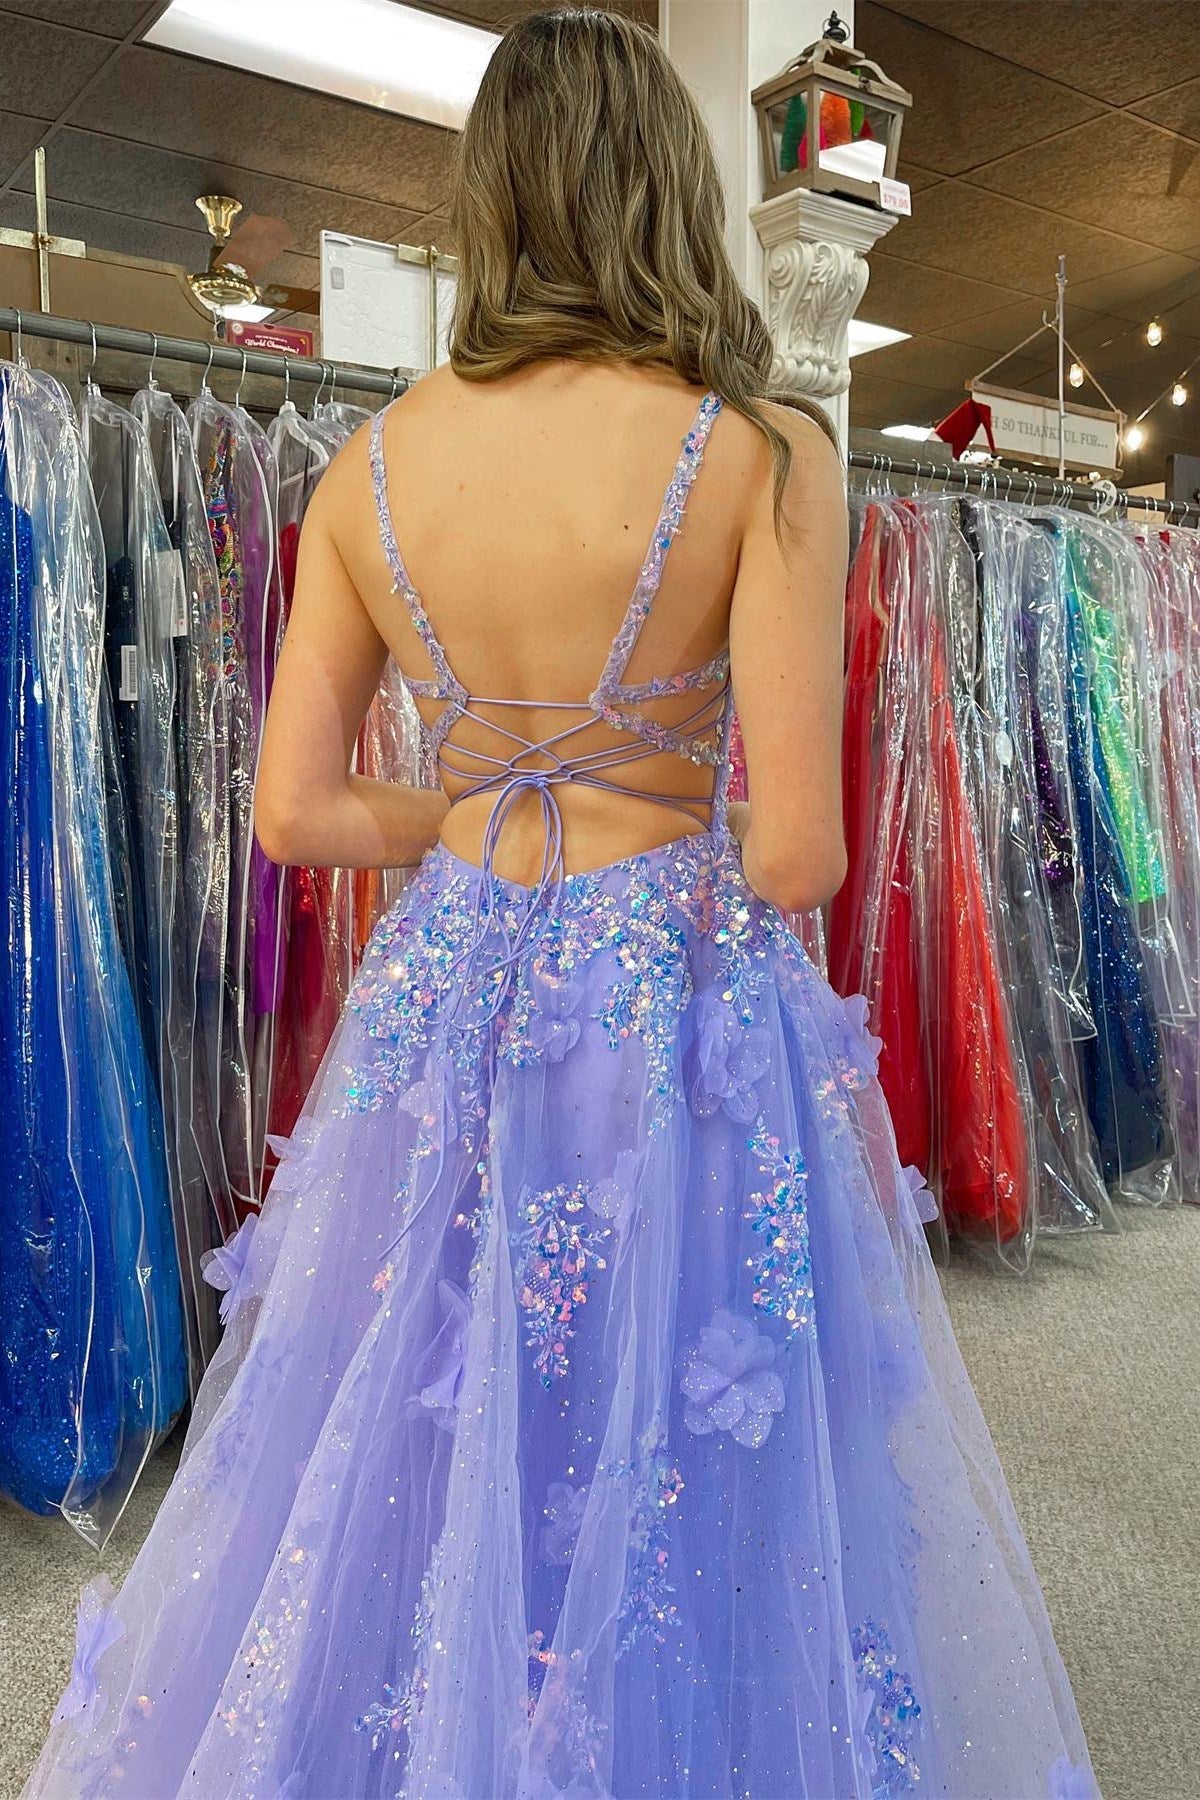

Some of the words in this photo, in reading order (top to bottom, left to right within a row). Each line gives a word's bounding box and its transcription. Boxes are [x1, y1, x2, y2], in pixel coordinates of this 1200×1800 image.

[244, 338, 266, 347] World
[1001, 418, 1015, 432] SO
[1017, 421, 1077, 443] THANKUL
